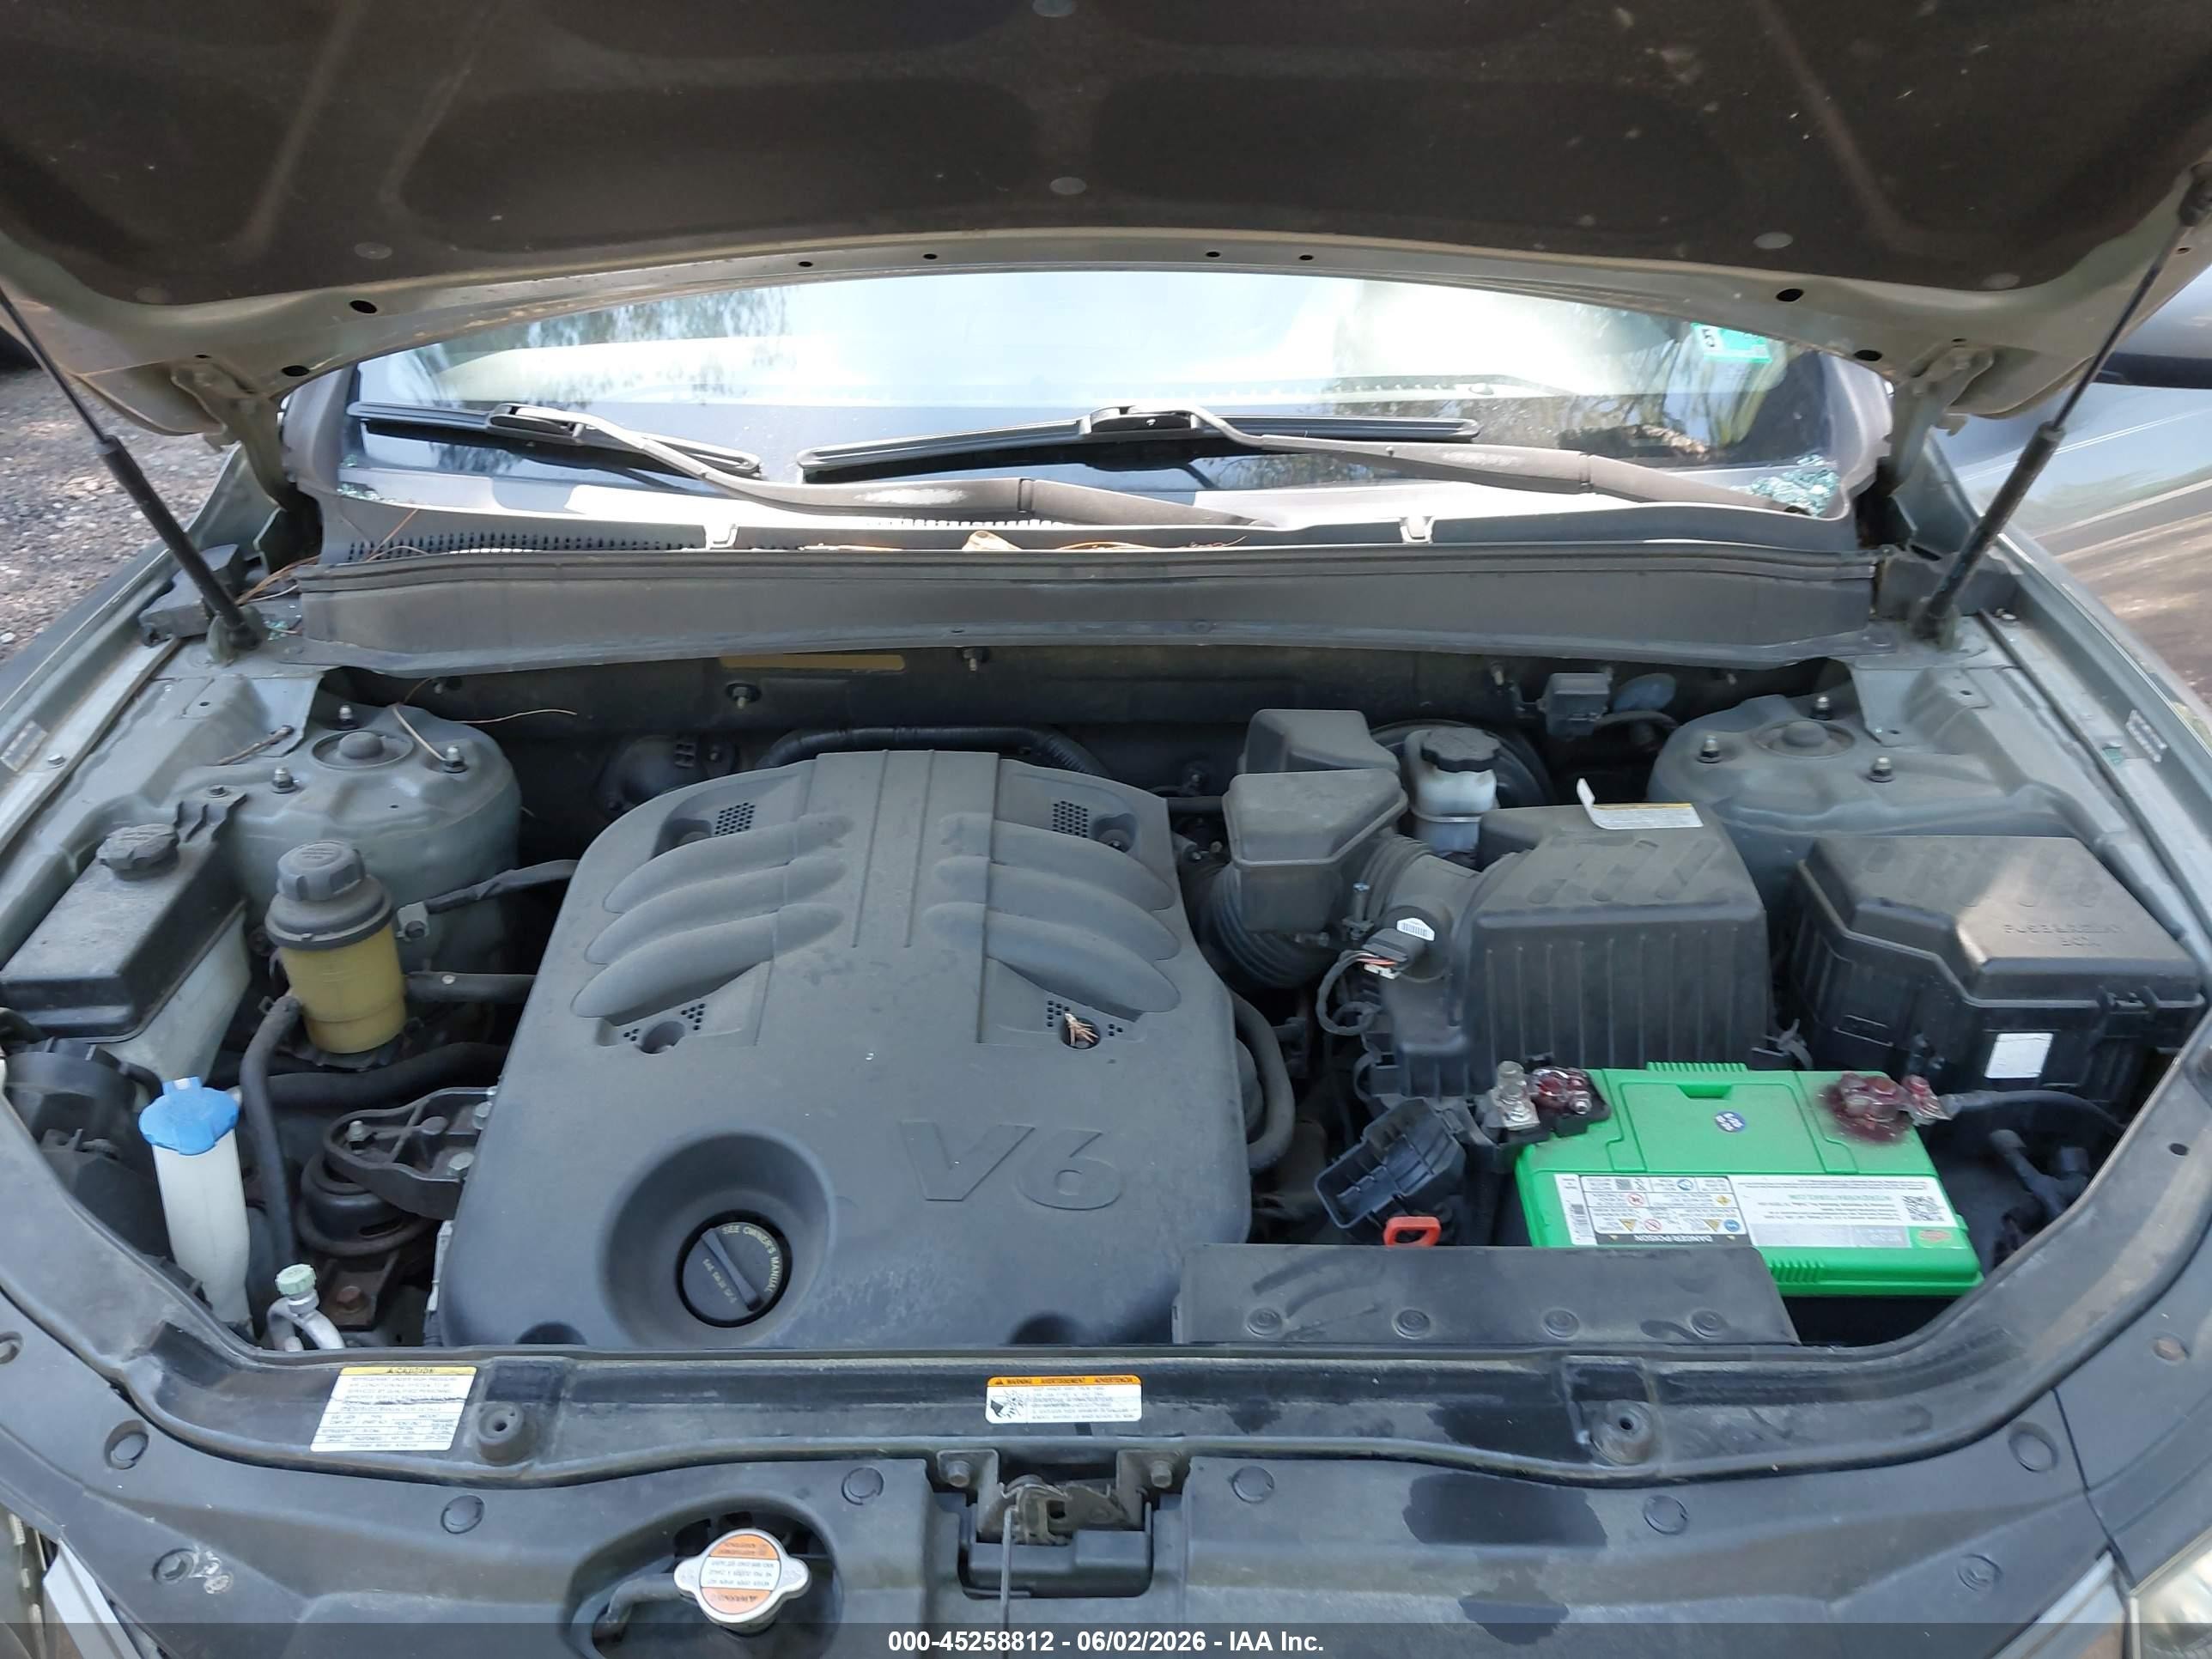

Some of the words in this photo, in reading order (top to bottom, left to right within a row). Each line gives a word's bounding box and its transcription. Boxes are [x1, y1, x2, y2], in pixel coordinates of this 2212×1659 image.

[897, 1120, 1123, 1212] V6
[721, 1224, 741, 1235] SEE
[763, 1256, 779, 1292] MANUAL
[1673, 1234, 1713, 1243] DANGER
